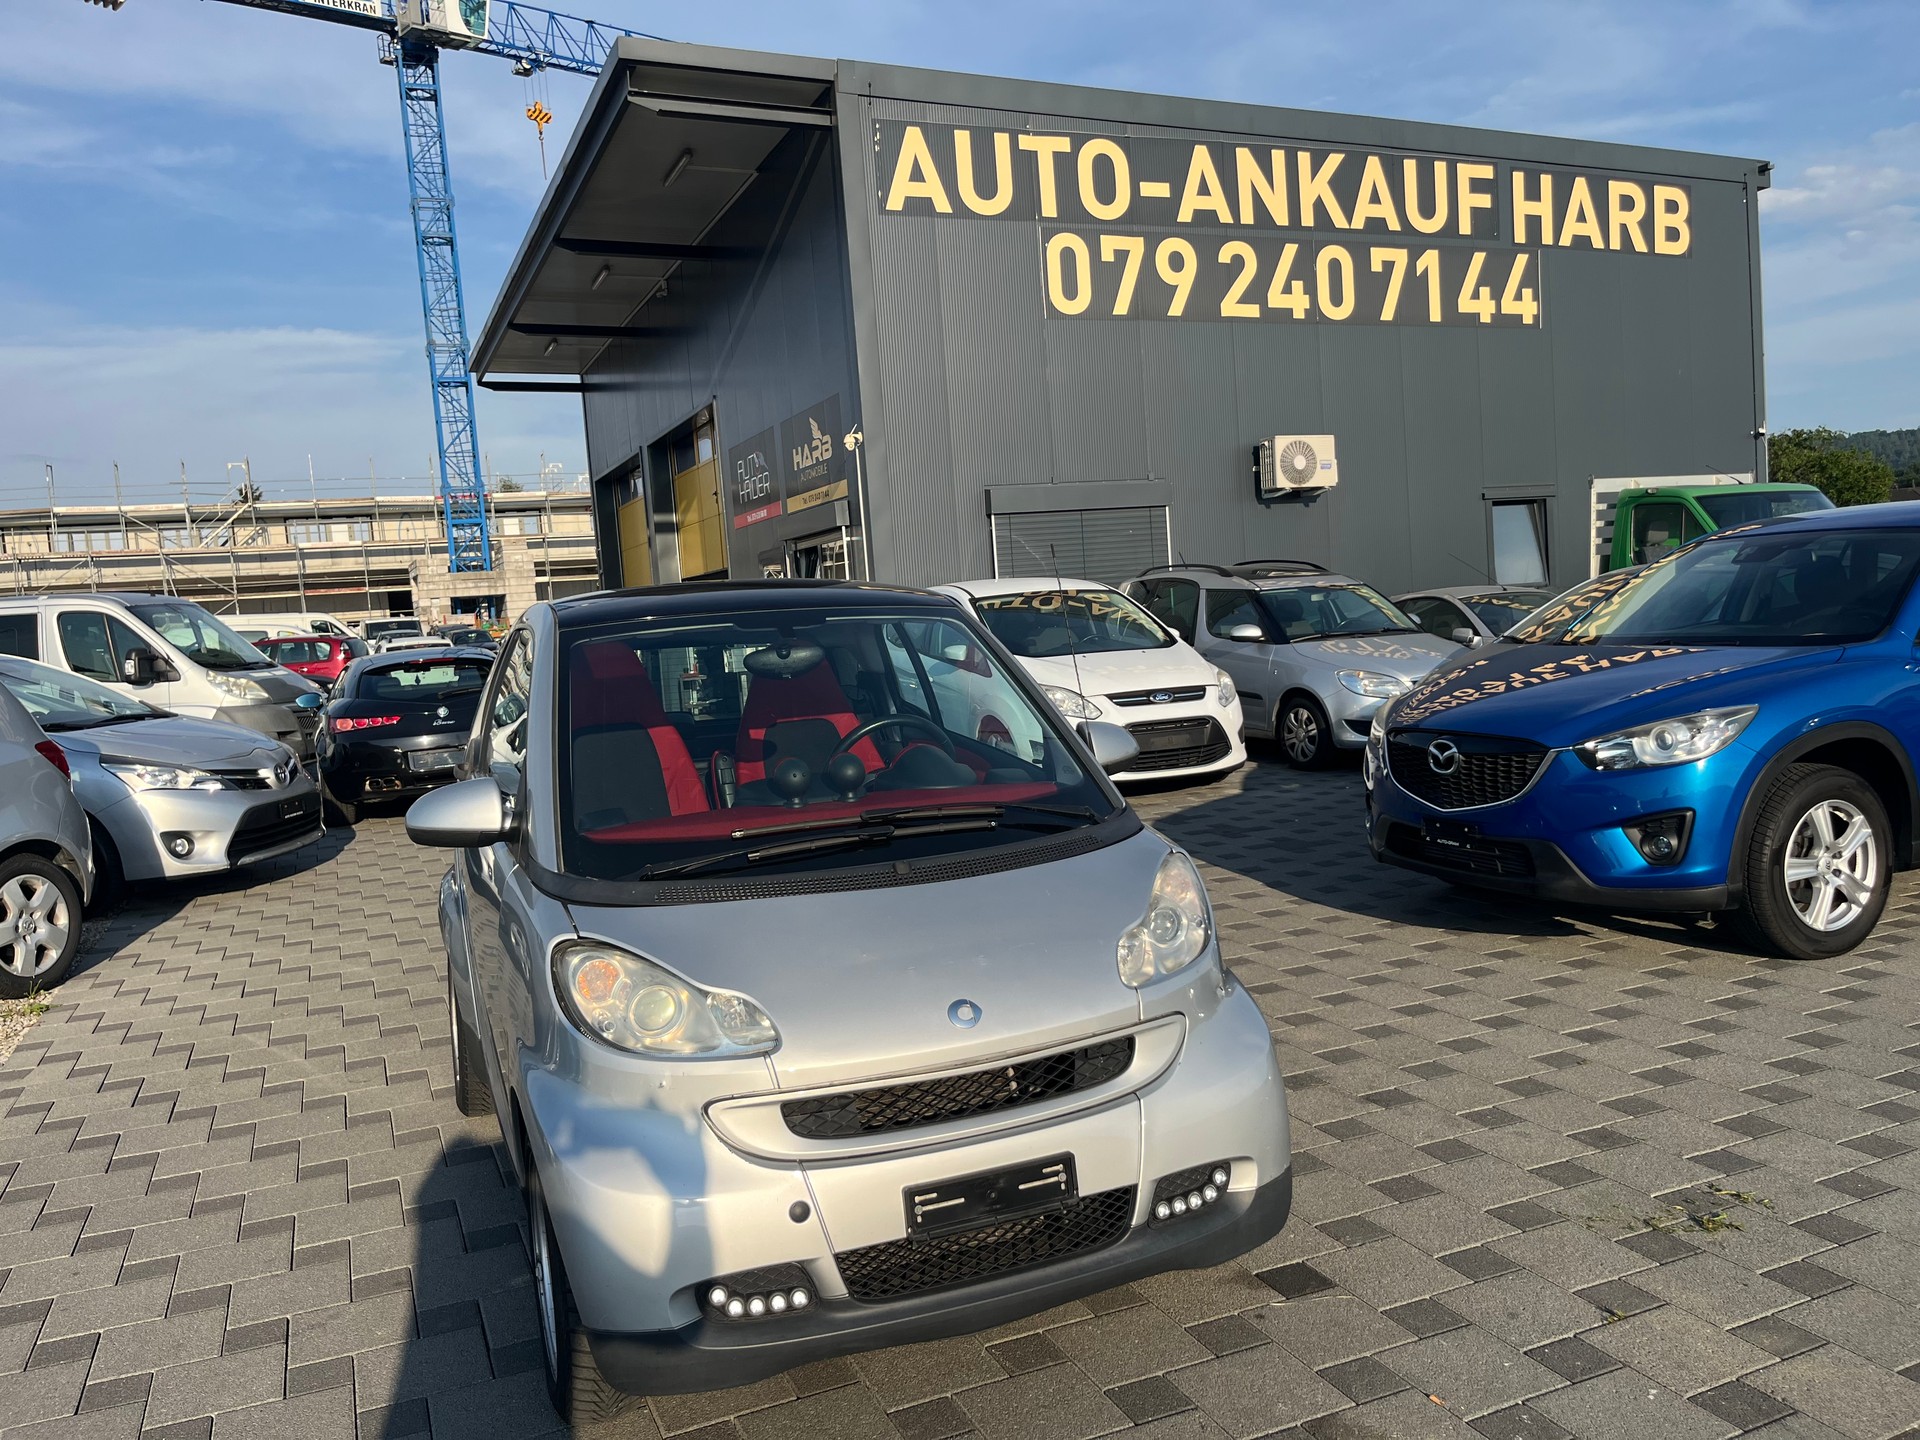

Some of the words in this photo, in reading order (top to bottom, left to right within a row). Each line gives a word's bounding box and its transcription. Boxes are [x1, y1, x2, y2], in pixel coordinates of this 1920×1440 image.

[313, 0, 377, 15] TERKRAN
[885, 125, 1496, 236] AUTO-ANKAUF
[1512, 169, 1692, 256] HARB
[1046, 232, 1199, 317] 079
[1217, 239, 1357, 322] 240
[792, 434, 833, 471] HARB
